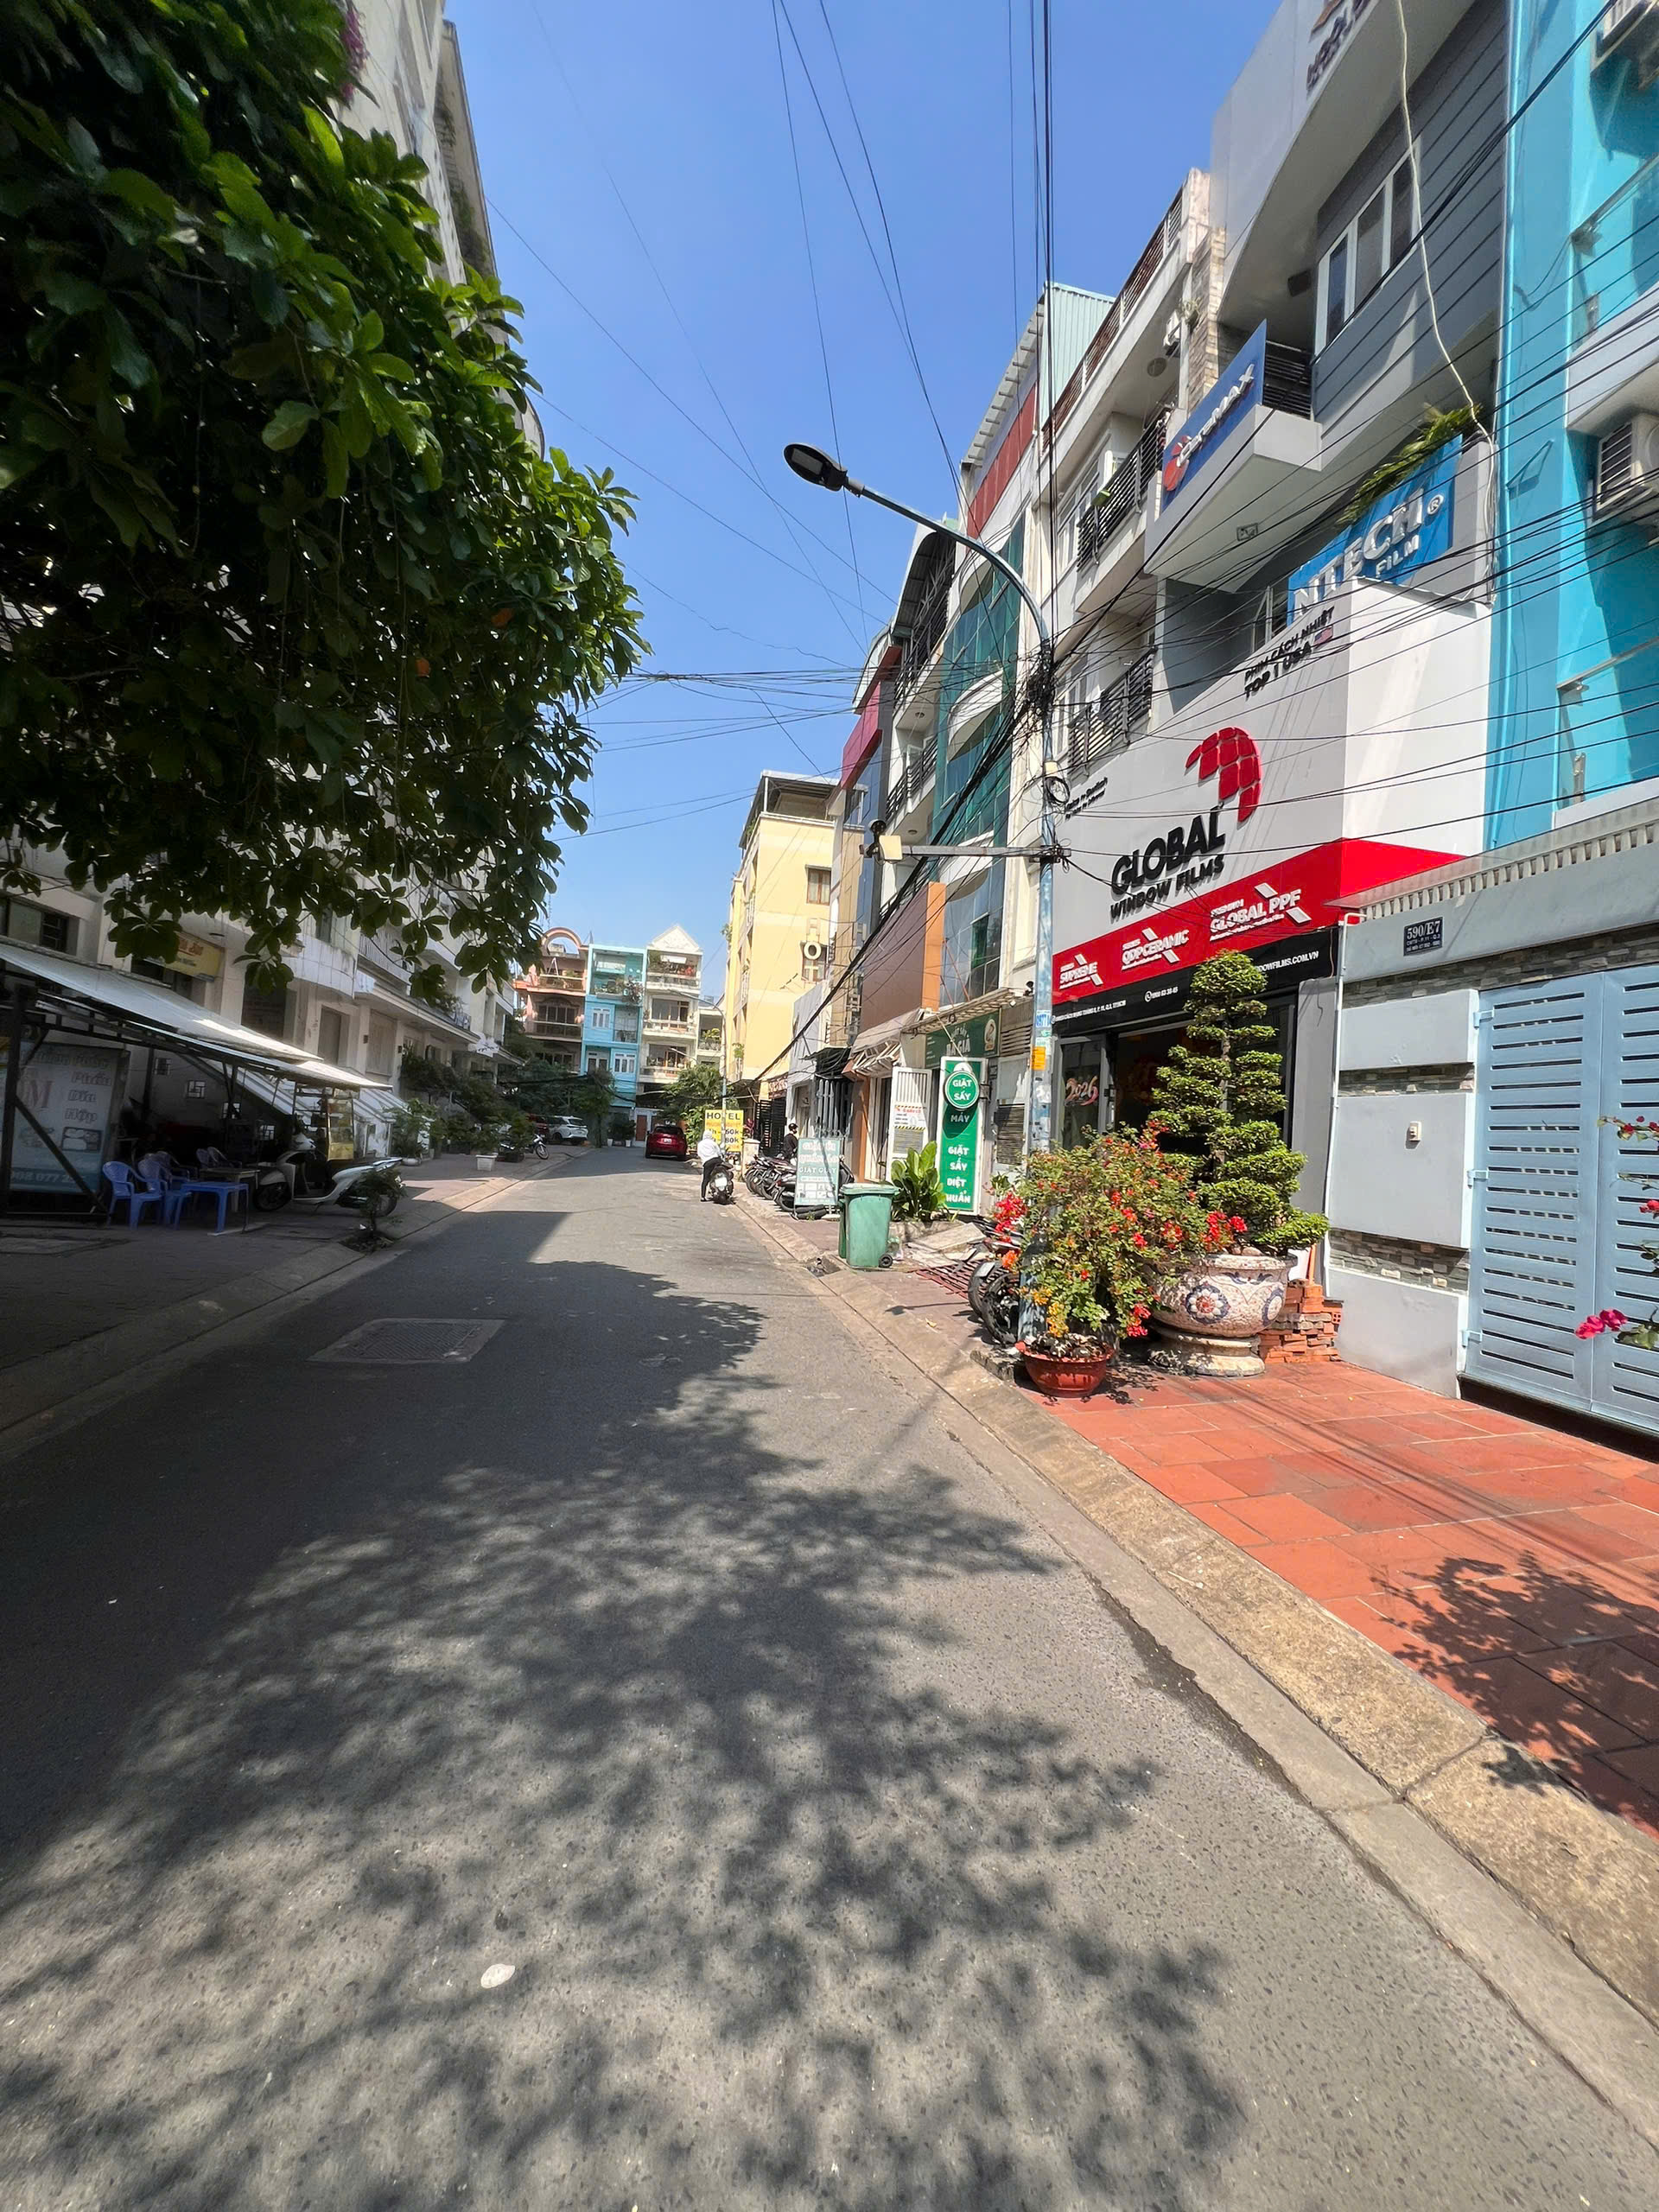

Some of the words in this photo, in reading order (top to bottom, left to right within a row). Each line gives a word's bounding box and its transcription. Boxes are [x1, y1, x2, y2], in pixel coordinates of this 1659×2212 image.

[1376, 534, 1420, 579] FILM
[1244, 671, 1270, 701] TOP
[1111, 804, 1226, 895] GLOBAL
[1110, 878, 1172, 919] WINDOW
[1176, 855, 1224, 893] FILMS
[1210, 902, 1267, 933] GLOBAL
[1269, 888, 1302, 914] PPF
[1406, 919, 1440, 940] 590/E7
[1143, 929, 1190, 957] CERAMIC
[1059, 961, 1098, 984] SUPREME
[952, 1077, 972, 1090] GIẶT
[953, 1090, 971, 1101] SẤY
[707, 1112, 741, 1121] HOEL
[950, 1112, 969, 1122] MÁY
[948, 1144, 969, 1157] GIẶT
[950, 1158, 968, 1171] SẤY
[947, 1176, 966, 1188] DIỆT
